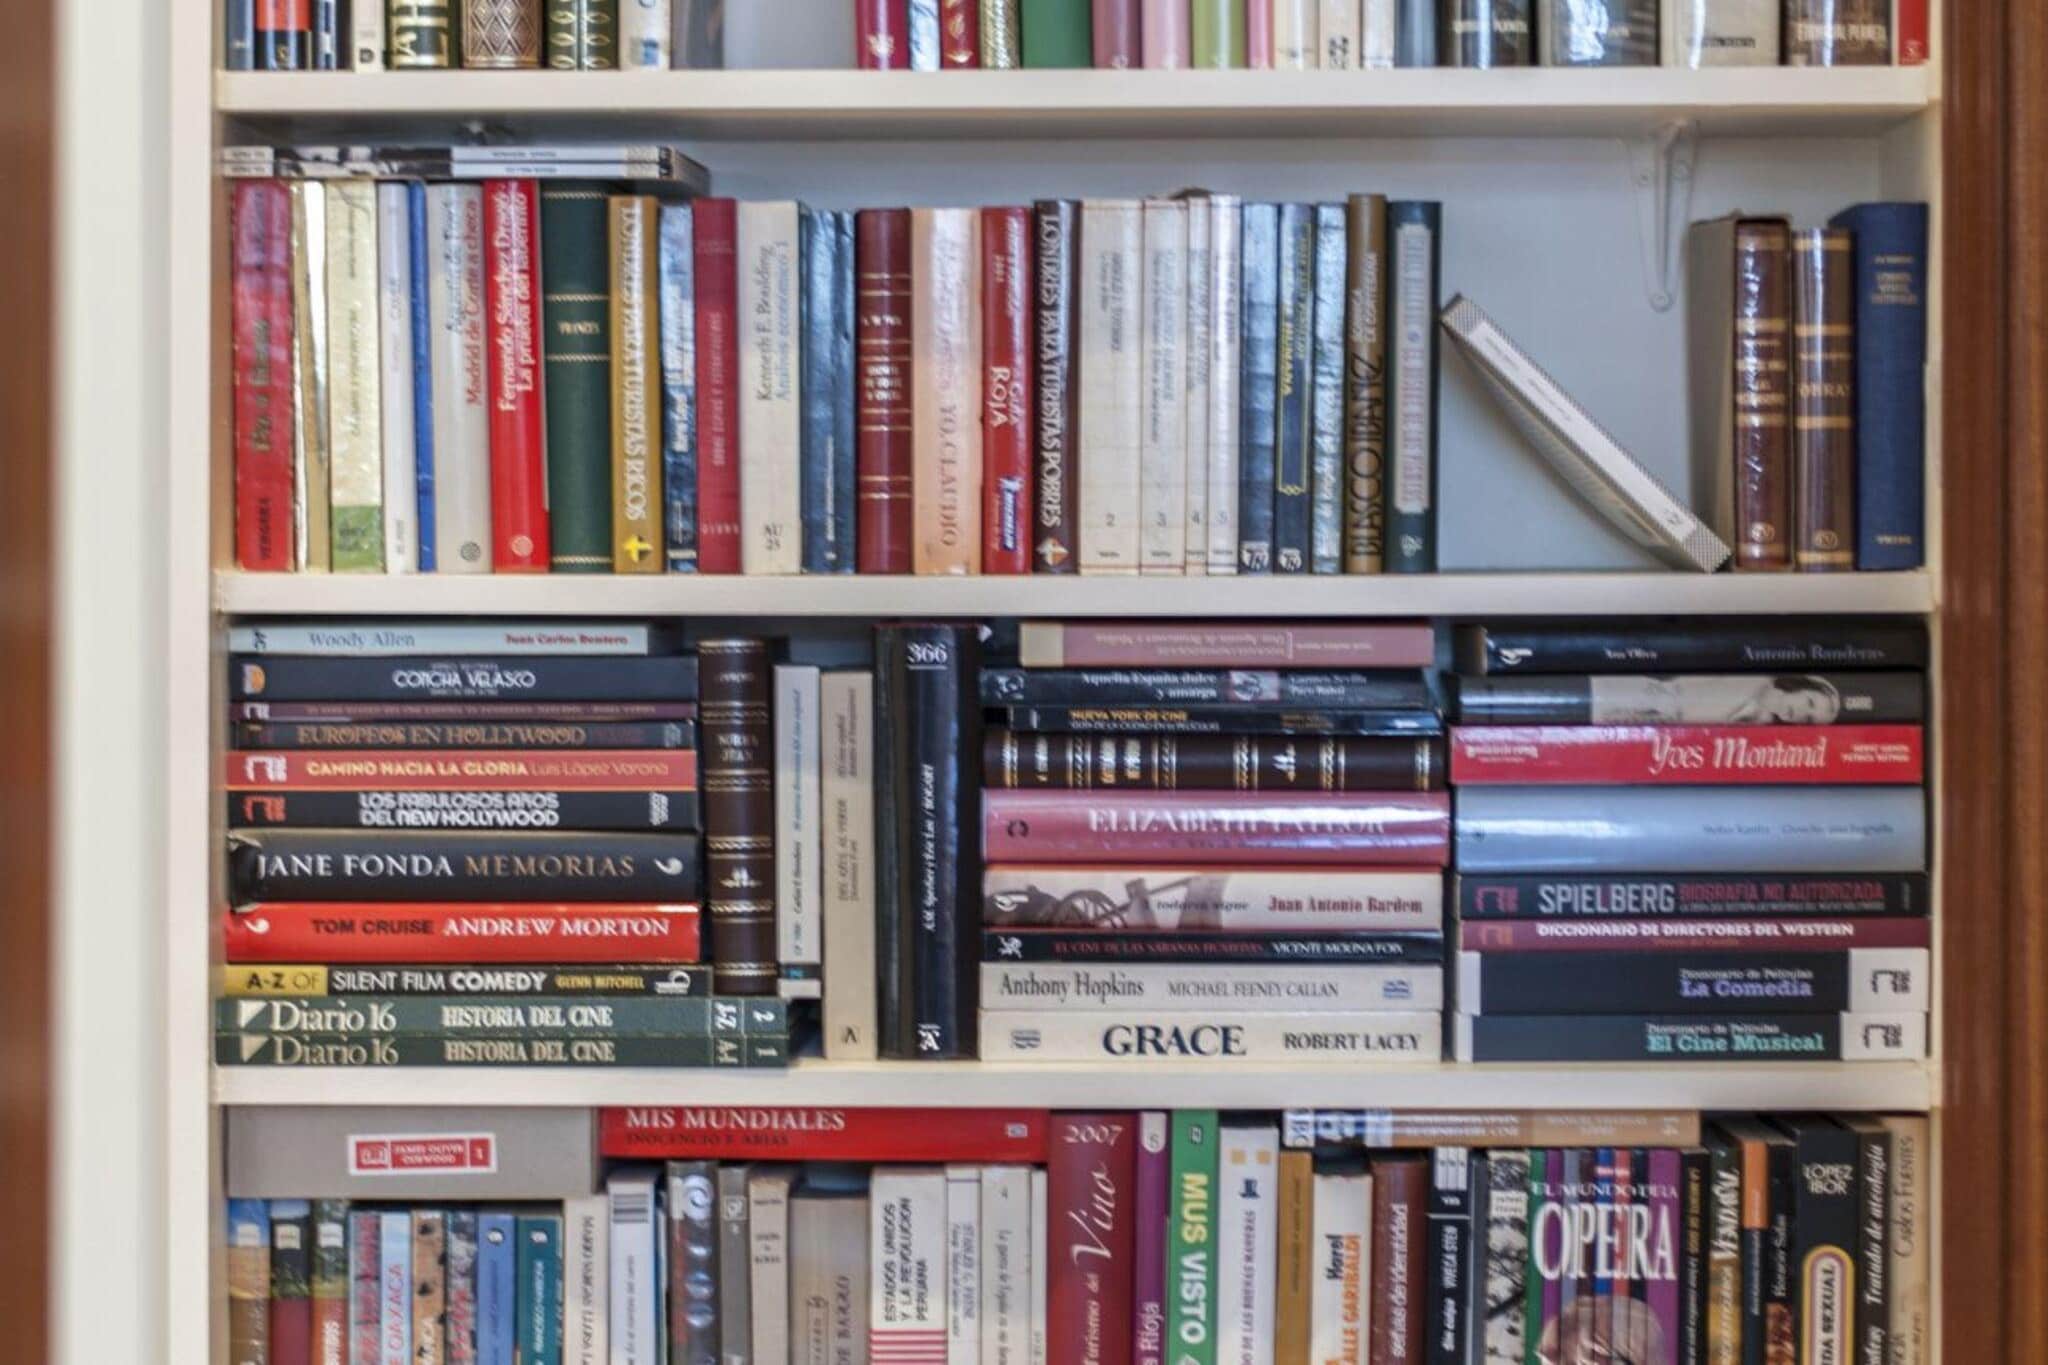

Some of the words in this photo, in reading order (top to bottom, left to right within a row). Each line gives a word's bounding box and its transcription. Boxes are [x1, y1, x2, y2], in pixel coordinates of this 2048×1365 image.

[1039, 213, 1059, 306] LONDRES
[497, 252, 514, 325] Sánchez
[465, 344, 480, 407] Madrid
[499, 328, 516, 411] Fernando
[755, 336, 770, 402] Kenneth
[988, 366, 1010, 428] ROJA
[625, 459, 646, 521] RICOS
[941, 439, 961, 547] CLAUDIO
[1042, 452, 1062, 529] POBRES
[1351, 446, 1385, 558] BLASCO
[307, 630, 367, 650] Woody
[372, 630, 416, 649] Allen
[505, 633, 534, 646] Juan
[536, 633, 577, 646] Carlos
[906, 642, 949, 665] 366
[1744, 644, 1808, 661] Antonio
[1810, 644, 1886, 661] Banderas
[391, 670, 463, 689] CONCHA
[467, 670, 537, 689] VELASCO
[1070, 710, 1110, 722] NUEVA
[1111, 710, 1144, 722] YORK
[1145, 710, 1159, 722] DE
[1160, 710, 1188, 722] CINE
[296, 724, 407, 746] EUROPEOS
[412, 725, 442, 745] EN
[446, 724, 587, 746] HOLLYWOOD
[306, 760, 379, 778] CAMINO
[380, 760, 437, 778] HACIA
[438, 761, 463, 777] LA
[463, 760, 529, 778] GLORIA
[1648, 734, 1705, 775] Yves
[1712, 735, 1828, 770] Montand
[358, 792, 397, 811] LOS
[397, 792, 505, 811] FABULOSOS
[358, 809, 397, 827] DEL
[397, 809, 441, 827] NEW
[441, 809, 561, 828] HOLLYWOOD
[1087, 807, 1256, 834] ELIZABETH
[257, 854, 334, 880] JANE
[343, 854, 455, 877] FONDA
[464, 854, 636, 877] MEMORIAS
[1267, 896, 1305, 914] Juan
[1307, 896, 1364, 914] Antonio
[1366, 896, 1424, 914] Bardem
[1537, 882, 1676, 914] SPIELBERG
[1679, 881, 1762, 901] BIOGRAFÍA
[1765, 883, 1788, 900] NO
[1789, 883, 1886, 900] AUTORIZADA
[312, 918, 356, 935] TOM
[361, 918, 433, 935] CRUISE
[441, 917, 555, 937] ANDREW
[559, 917, 671, 937] MORTON
[1535, 922, 1639, 938] DICCIONARIO
[1640, 922, 1660, 938] DE
[1662, 922, 1752, 938] DIRECTORES
[1754, 922, 1781, 938] DEL
[1783, 922, 1855, 938] WESTERN
[1272, 941, 1323, 953] VICENTE
[246, 972, 286, 990] A-Z
[291, 973, 320, 990] OF
[331, 971, 398, 992] SILENT
[401, 971, 446, 992] FILM
[450, 971, 548, 992] COMEDY
[1000, 972, 1070, 1003] Anthony
[1074, 971, 1144, 1003] Hopkins
[1168, 980, 1231, 998] MICHAEL
[1233, 980, 1283, 998] FEENEY
[1285, 980, 1339, 998] CALLAN
[1679, 980, 1712, 998] La
[1715, 980, 1813, 998] Comedia
[270, 1000, 365, 1033] Diario
[368, 1001, 398, 1032] 16
[441, 1004, 526, 1028] HISTORIA
[528, 1005, 567, 1028] DEL
[568, 1005, 615, 1028] CINE
[273, 1034, 369, 1066] Diario
[372, 1037, 400, 1066] 16
[443, 1039, 529, 1063] HISTORIA
[530, 1041, 569, 1063] DEL
[570, 1041, 617, 1063] CINE
[1101, 1024, 1247, 1056] GRACE
[1283, 1032, 1361, 1051] ROBERT
[1363, 1032, 1422, 1051] LACEY
[1645, 1033, 1673, 1053] El
[1677, 1033, 1729, 1053] Cine
[1732, 1033, 1826, 1053] Musical
[624, 1108, 677, 1130] MIS
[683, 1109, 847, 1131] MUNDIALES
[1062, 1124, 1124, 1144] 2007
[1808, 1180, 1849, 1195] IBOR
[1866, 1143, 1888, 1219] ateología
[1067, 1160, 1117, 1265] Vino
[1180, 1172, 1209, 1244] MUS
[884, 1203, 896, 1256] UNIDOS
[1241, 1209, 1256, 1264] MANERAS
[1388, 1203, 1408, 1284] identidad
[1532, 1202, 1678, 1281] OPERA
[1866, 1220, 1884, 1241] de
[1085, 1272, 1100, 1294] del
[1343, 1234, 1361, 1324] GARIBALDI
[1864, 1242, 1884, 1306] Tratado
[884, 1260, 897, 1323] ESTADOS
[899, 1288, 911, 1306] LA
[916, 1259, 928, 1322] PERUANA
[1179, 1251, 1208, 1345] VISTO
[1821, 1264, 1836, 1334] SEXUAL
[900, 1312, 911, 1322] Y
[1140, 1301, 1165, 1352] Rioja
[1243, 1312, 1256, 1334] LAS
[1243, 1336, 1256, 1351] DE
